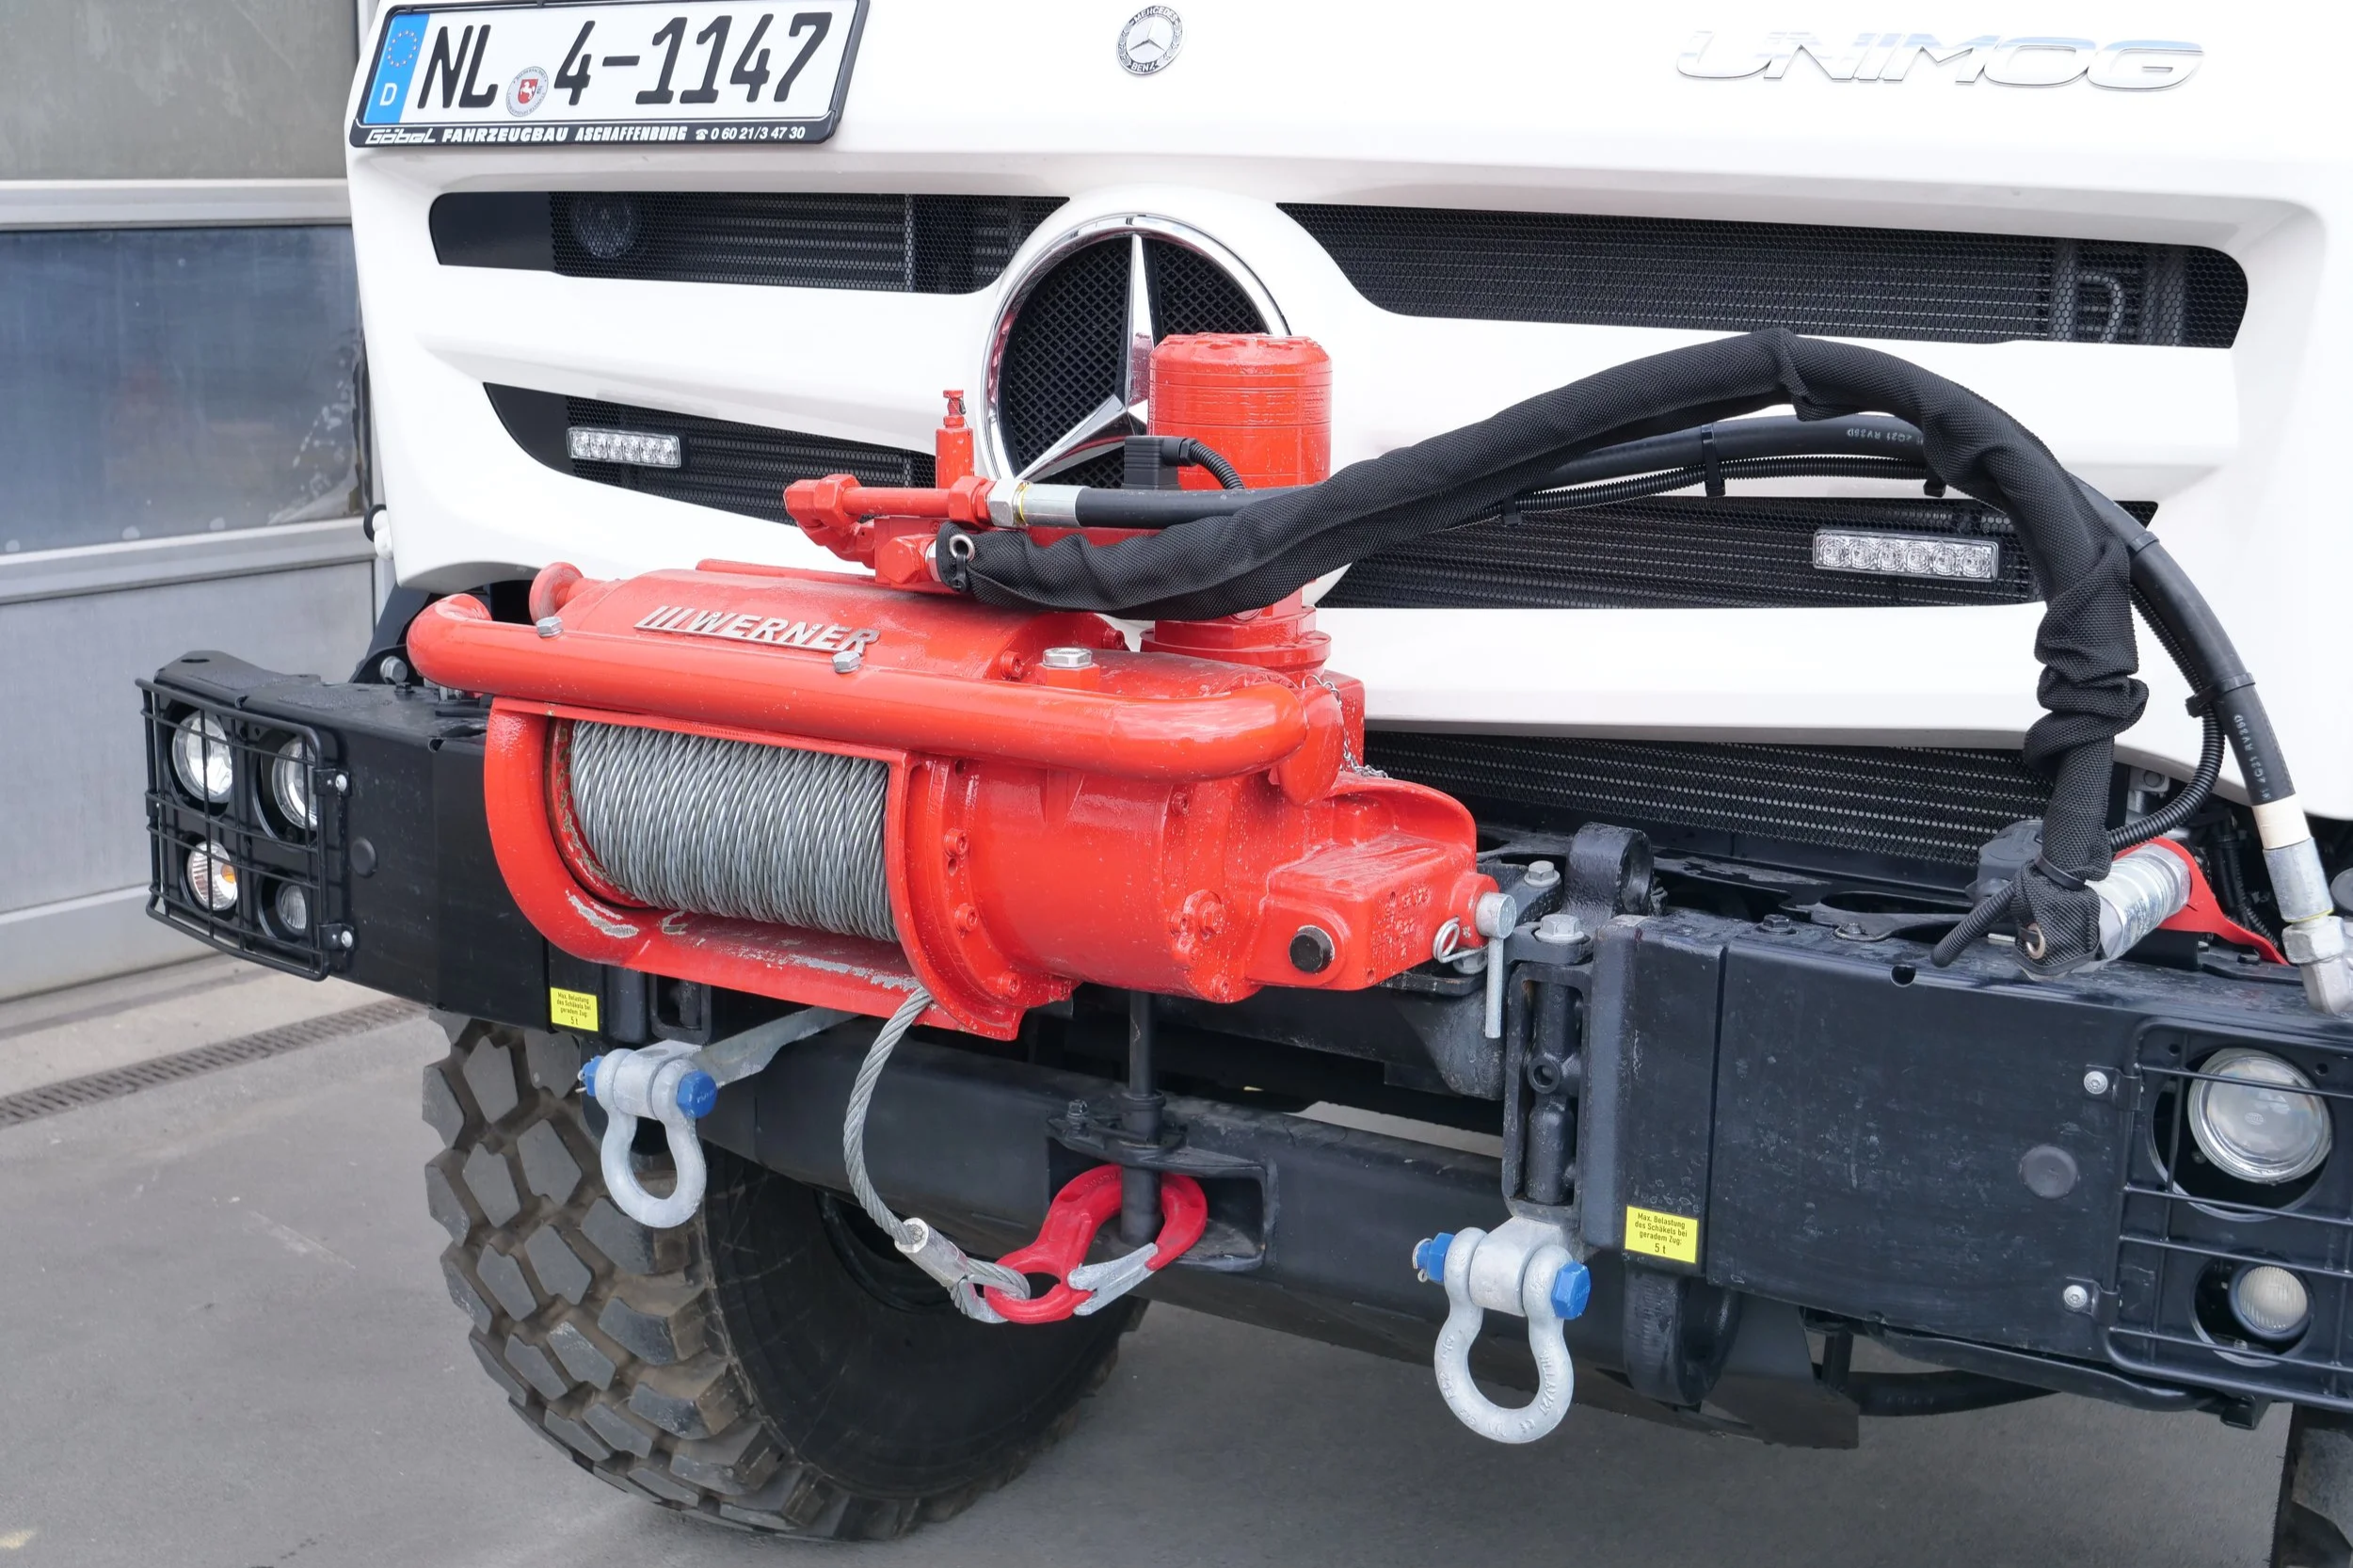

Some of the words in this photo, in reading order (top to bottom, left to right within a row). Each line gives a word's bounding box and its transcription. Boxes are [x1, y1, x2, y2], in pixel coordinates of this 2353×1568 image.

[1132, 6, 1178, 23] MERCEDES
[417, 24, 498, 109] NL
[553, 12, 833, 105] 4-1147
[1130, 62, 1156, 72] BENZ
[1675, 31, 2205, 91] UNIMOG
[379, 83, 397, 107] D
[441, 126, 569, 143] FAHRZEUGBAU
[575, 125, 688, 141] ASCHAFFENBURG
[690, 610, 881, 656] WERNER
[1637, 1212, 1653, 1223] Max.
[1654, 1215, 1686, 1229] Belastung
[1634, 1221, 1646, 1229] des
[1647, 1223, 1676, 1236] Schäkels
[1677, 1229, 1688, 1238] bei
[1639, 1230, 1668, 1242] geradem
[1655, 1242, 1660, 1253] 5
[1662, 1245, 1666, 1255] t
